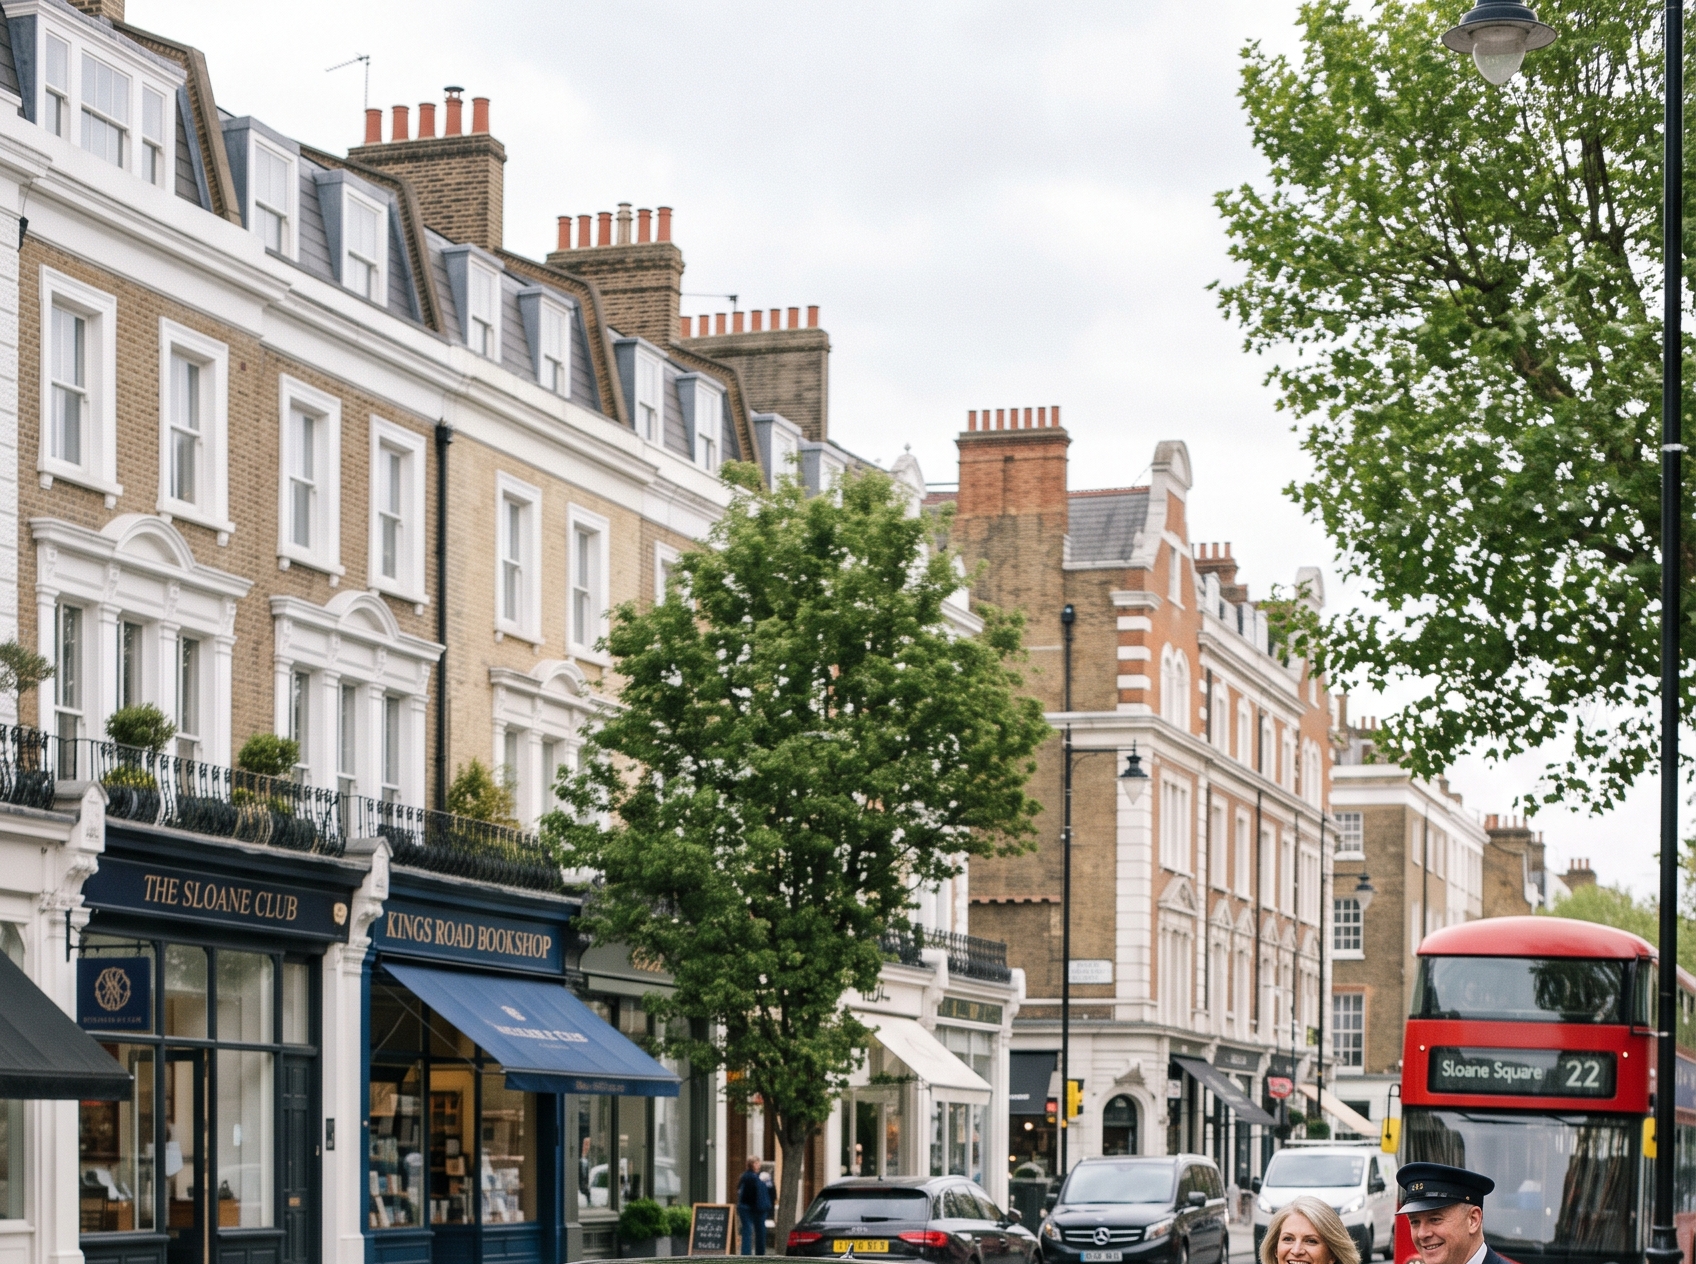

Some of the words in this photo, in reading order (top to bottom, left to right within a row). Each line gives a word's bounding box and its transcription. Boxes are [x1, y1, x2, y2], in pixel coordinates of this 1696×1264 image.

[144, 874, 179, 905] THE
[182, 880, 252, 914] SLOANE
[255, 891, 298, 921] CLUB
[386, 911, 432, 943] KINGS
[434, 919, 475, 948] ROAD
[477, 926, 552, 959] BOOKSHOP
[1442, 1060, 1489, 1078] Sloane
[1493, 1061, 1543, 1084] Square
[1565, 1060, 1600, 1088] 22
